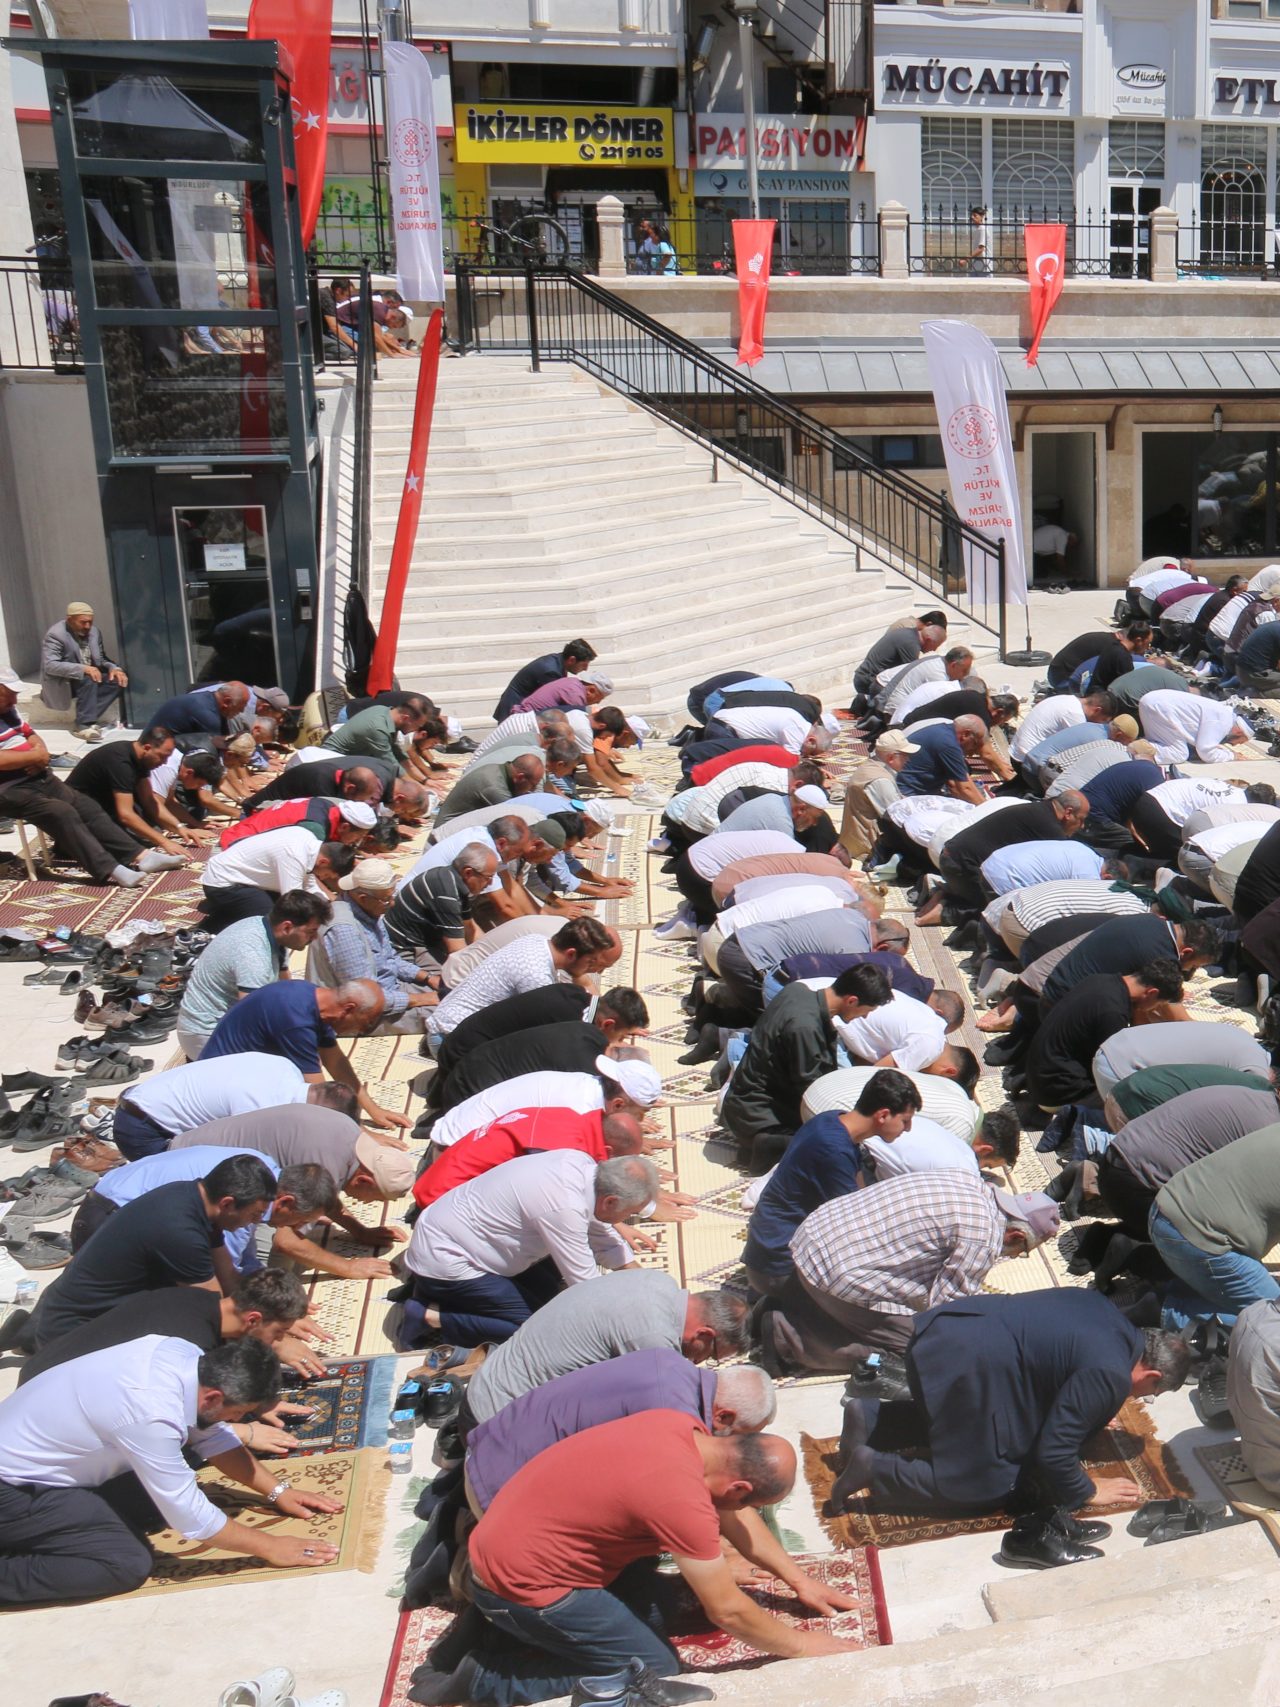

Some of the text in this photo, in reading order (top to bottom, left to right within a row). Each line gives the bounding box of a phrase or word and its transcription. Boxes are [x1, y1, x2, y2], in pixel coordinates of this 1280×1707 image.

[886, 58, 1070, 97] MÜCAHİT
[467, 108, 664, 141] İKİZLER DÖNER
[601, 147, 664, 159] 221 91 05
[738, 177, 850, 192] GK-AY PANSİYON
